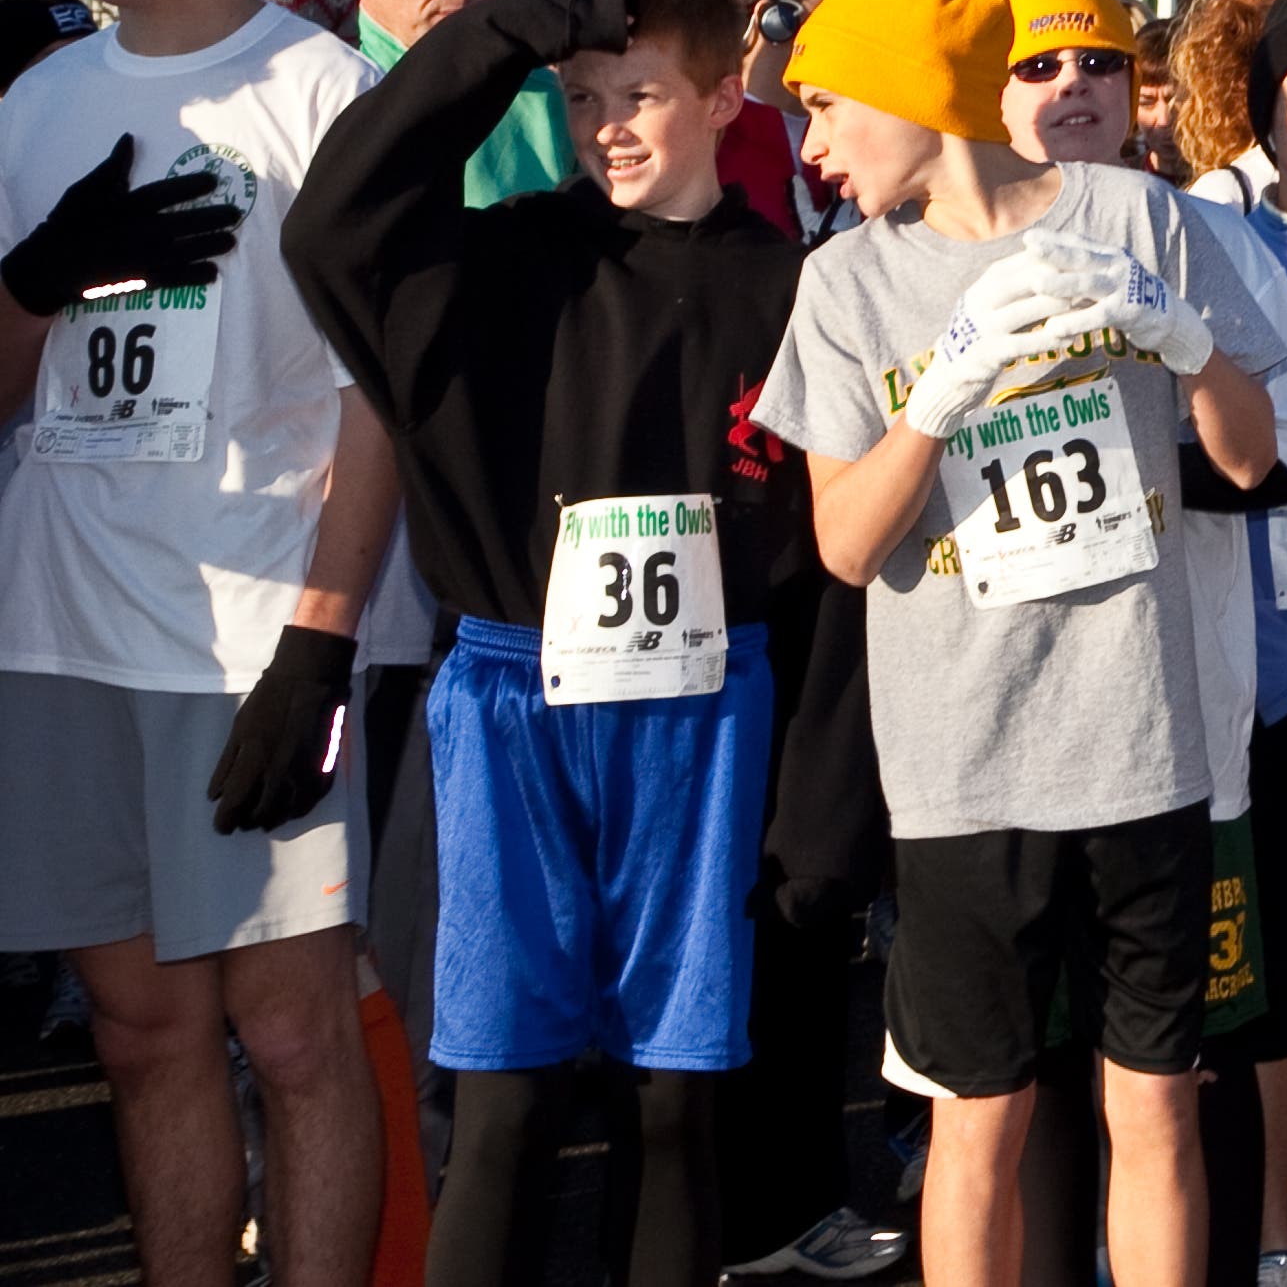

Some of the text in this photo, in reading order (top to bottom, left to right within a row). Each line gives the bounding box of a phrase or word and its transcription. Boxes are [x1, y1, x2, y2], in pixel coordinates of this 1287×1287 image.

[159, 285, 207, 311] Owls
[88, 323, 156, 398] 86
[946, 388, 1111, 460] Fly with the Owls
[732, 458, 768, 482] JBH
[980, 438, 1107, 533] 163
[563, 501, 713, 549] Fly with the Owls
[597, 551, 680, 628] 36
